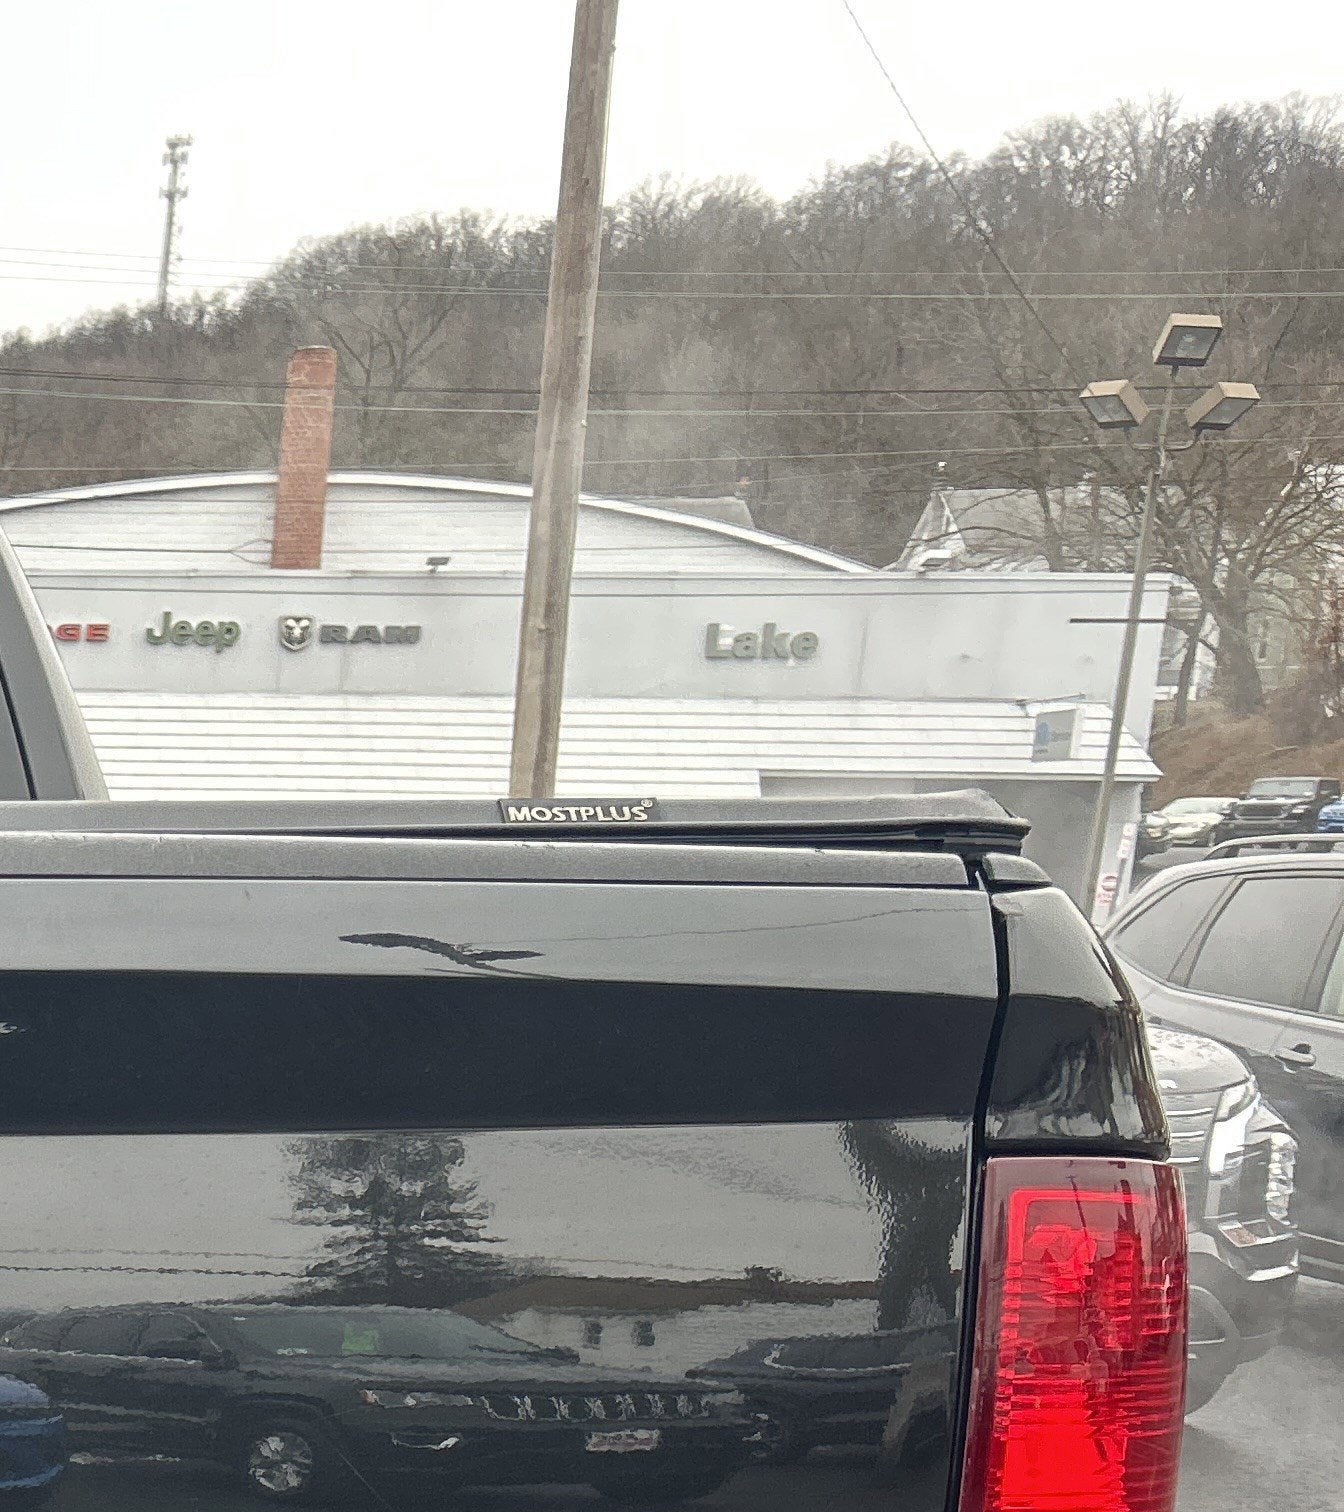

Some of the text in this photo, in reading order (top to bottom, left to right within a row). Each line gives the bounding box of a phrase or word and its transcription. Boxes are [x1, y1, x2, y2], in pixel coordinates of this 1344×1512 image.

[46, 623, 110, 641] GE
[145, 611, 242, 653] Jeep
[319, 624, 422, 644] RAM
[705, 622, 820, 660] Lake
